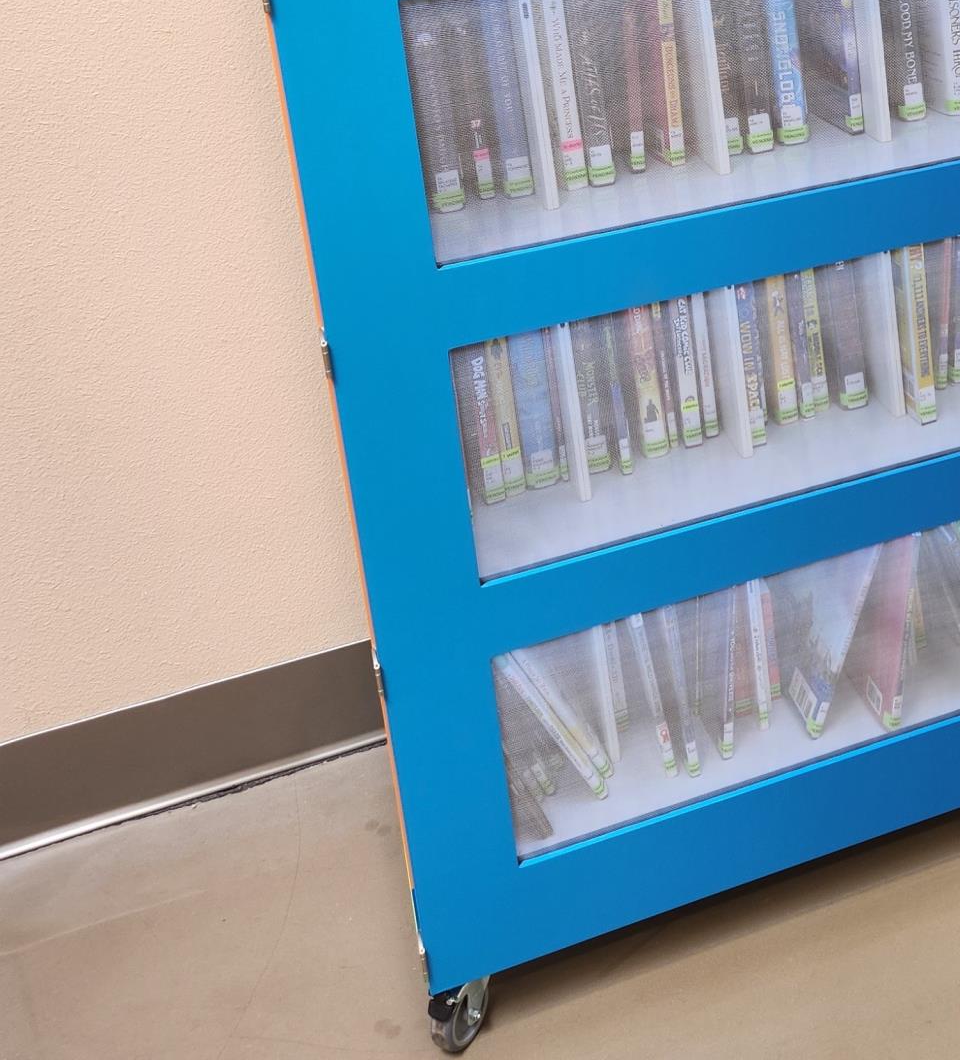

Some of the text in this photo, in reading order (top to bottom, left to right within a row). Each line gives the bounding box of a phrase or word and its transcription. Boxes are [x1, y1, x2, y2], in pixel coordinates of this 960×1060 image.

[902, 33, 914, 49] MY
[772, 11, 795, 106] SNOWGLOB
[905, 51, 918, 83] BONE
[677, 298, 686, 315] CAT
[678, 315, 689, 331] KID
[740, 320, 753, 355] WOW
[680, 330, 691, 356] COMIC
[470, 355, 488, 401] DOG MAN
[744, 356, 755, 371] IN
[746, 373, 761, 410] SPAC
